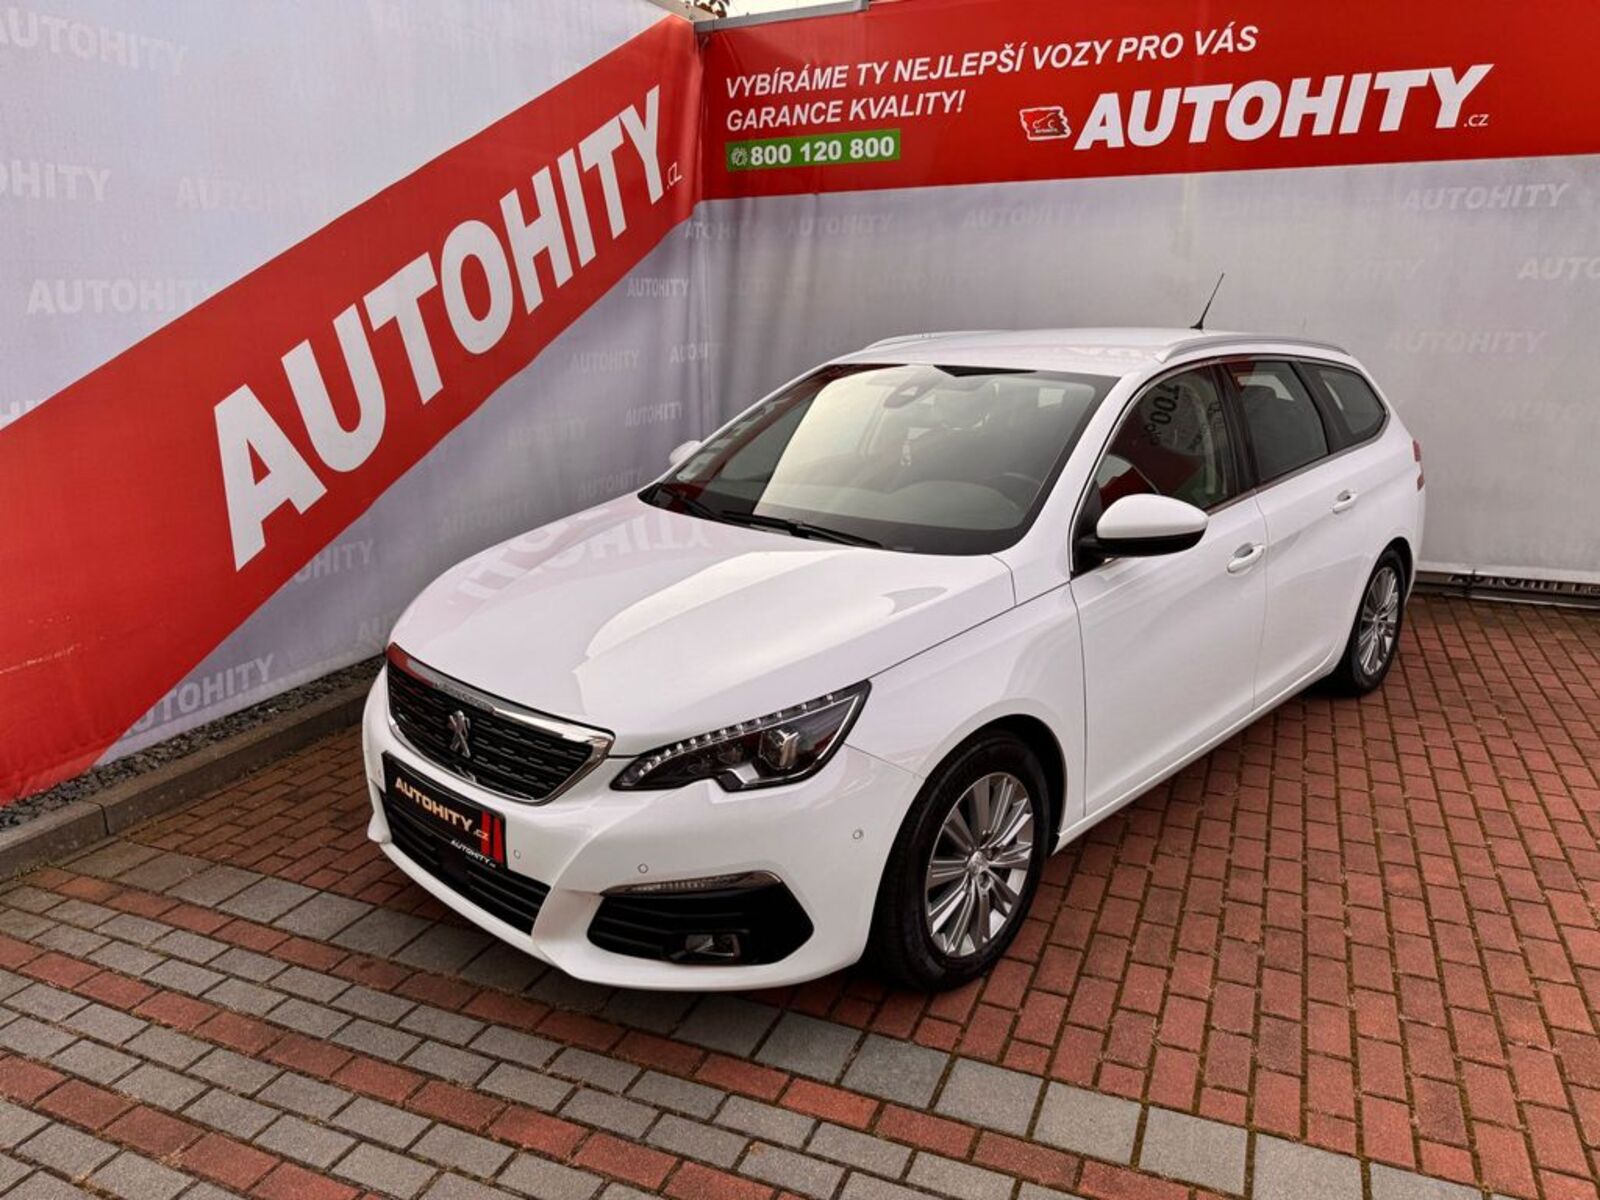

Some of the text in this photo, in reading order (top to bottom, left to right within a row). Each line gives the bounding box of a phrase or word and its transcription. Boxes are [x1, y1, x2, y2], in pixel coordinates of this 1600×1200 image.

[726, 21, 1259, 99] VYBÍRÁME TY NEJLEPŠÍ VOZY PRO VÁS
[726, 89, 967, 131] GARANCE KVALITY!
[1073, 64, 1495, 150] AUTOHITY
[751, 136, 894, 166] 800 120 800
[1402, 182, 1570, 210] AUTOHITY
[627, 277, 689, 298] AUTOHITY
[214, 84, 663, 573] AUTOHITY
[571, 349, 641, 374] AUTOHITY
[394, 777, 473, 832] AUTOHITY
